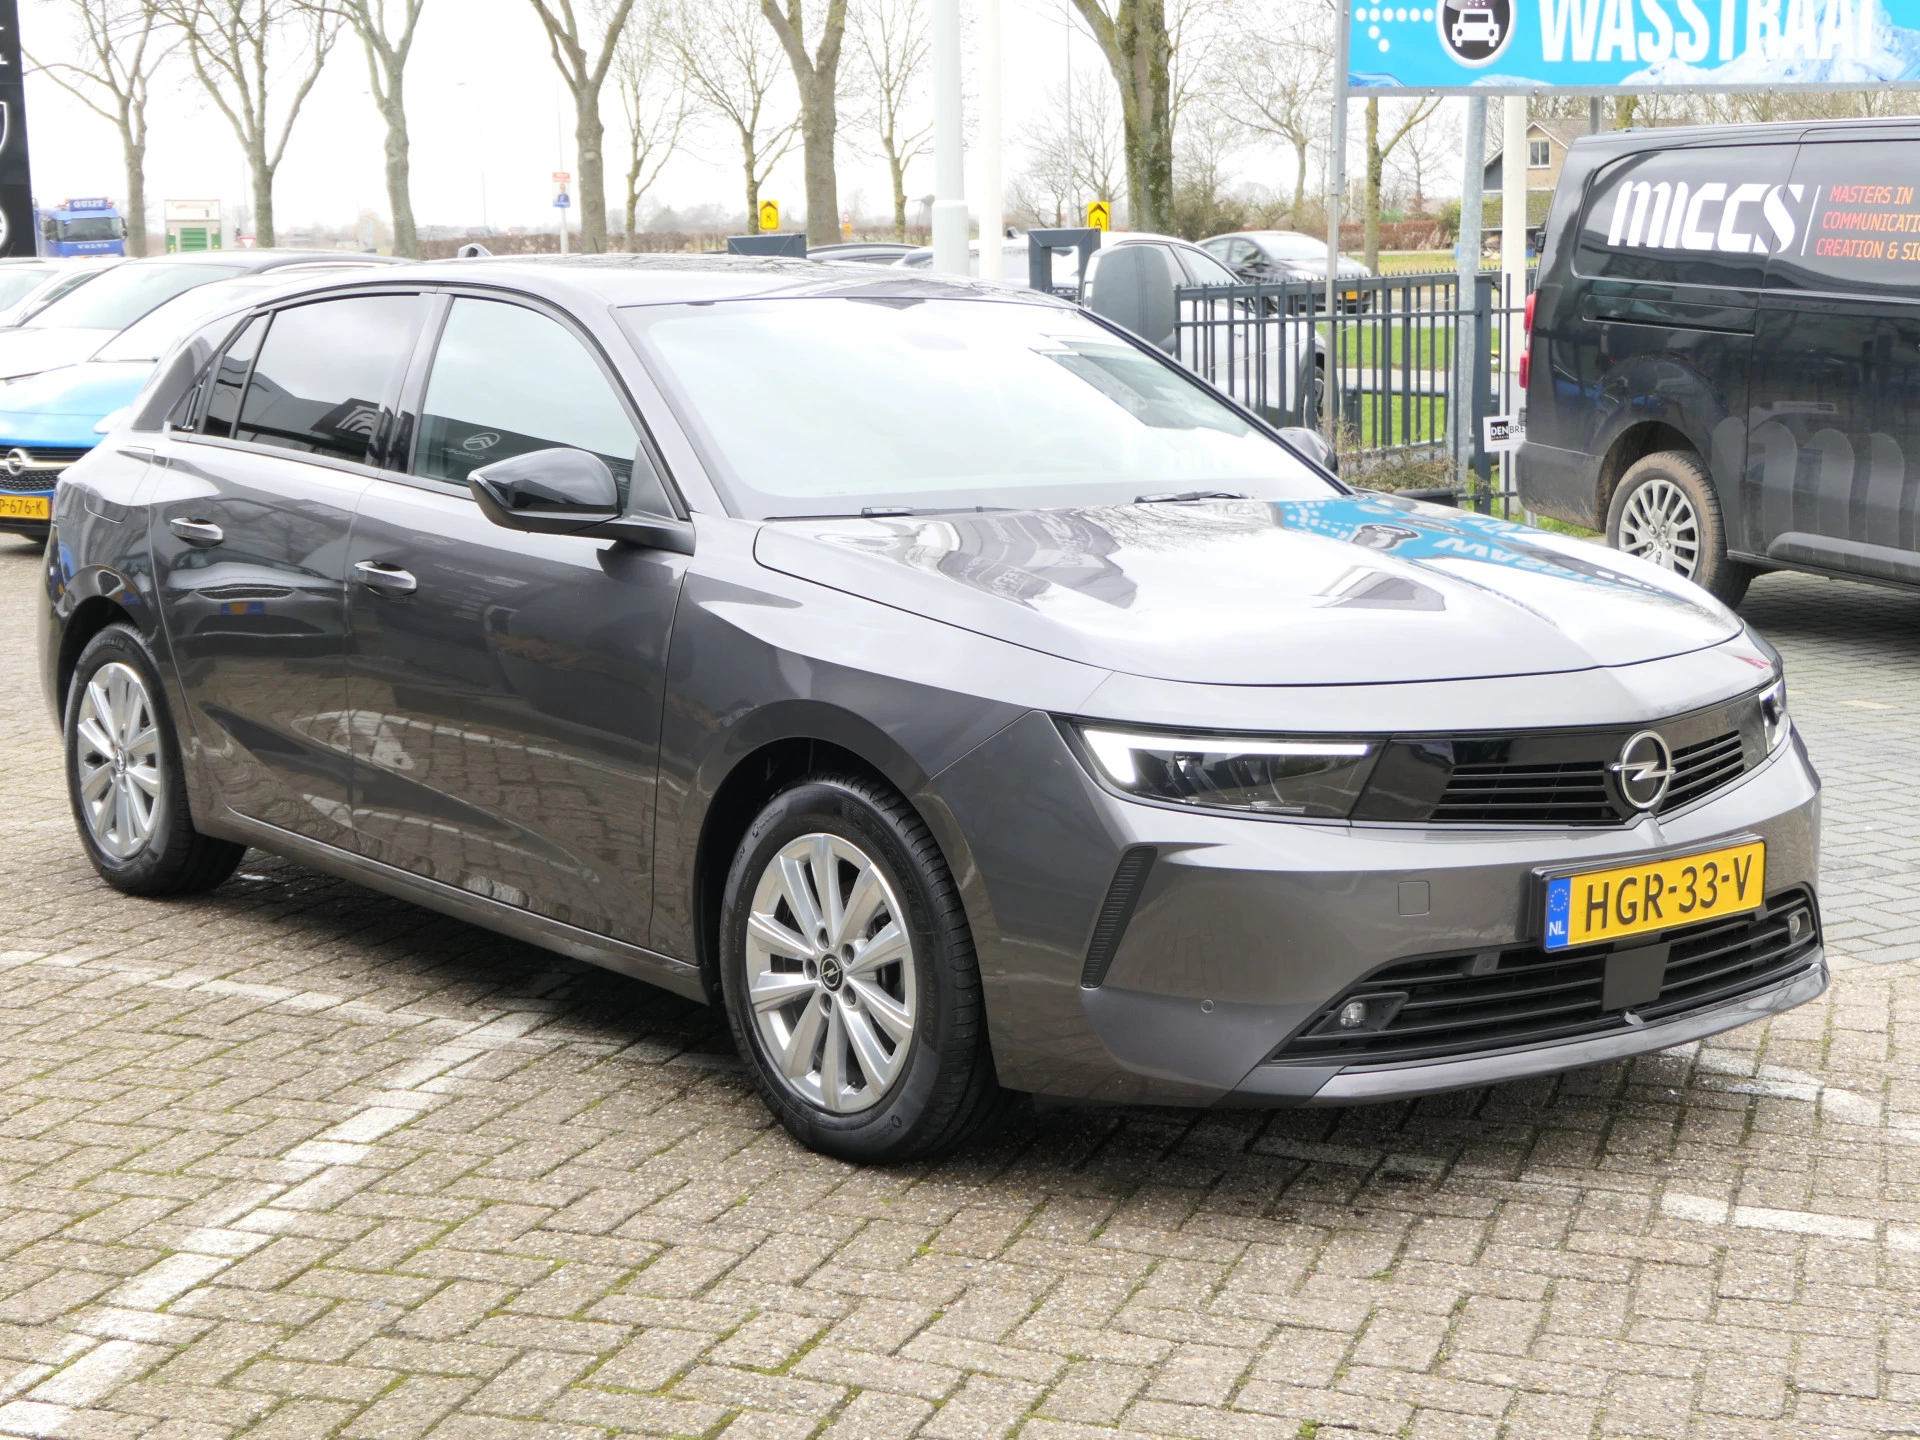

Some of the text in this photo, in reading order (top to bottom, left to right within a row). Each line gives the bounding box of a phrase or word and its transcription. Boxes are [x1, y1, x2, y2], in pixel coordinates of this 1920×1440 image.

[1829, 184, 1915, 205] MASTERS IN
[1094, 217, 1103, 228] A
[1822, 211, 1920, 233] COMMUNICATI
[1816, 238, 1885, 259] CREATION
[1886, 241, 1899, 260] &
[1584, 853, 1753, 933] HGR-33-V
[1548, 920, 1566, 937] NL
